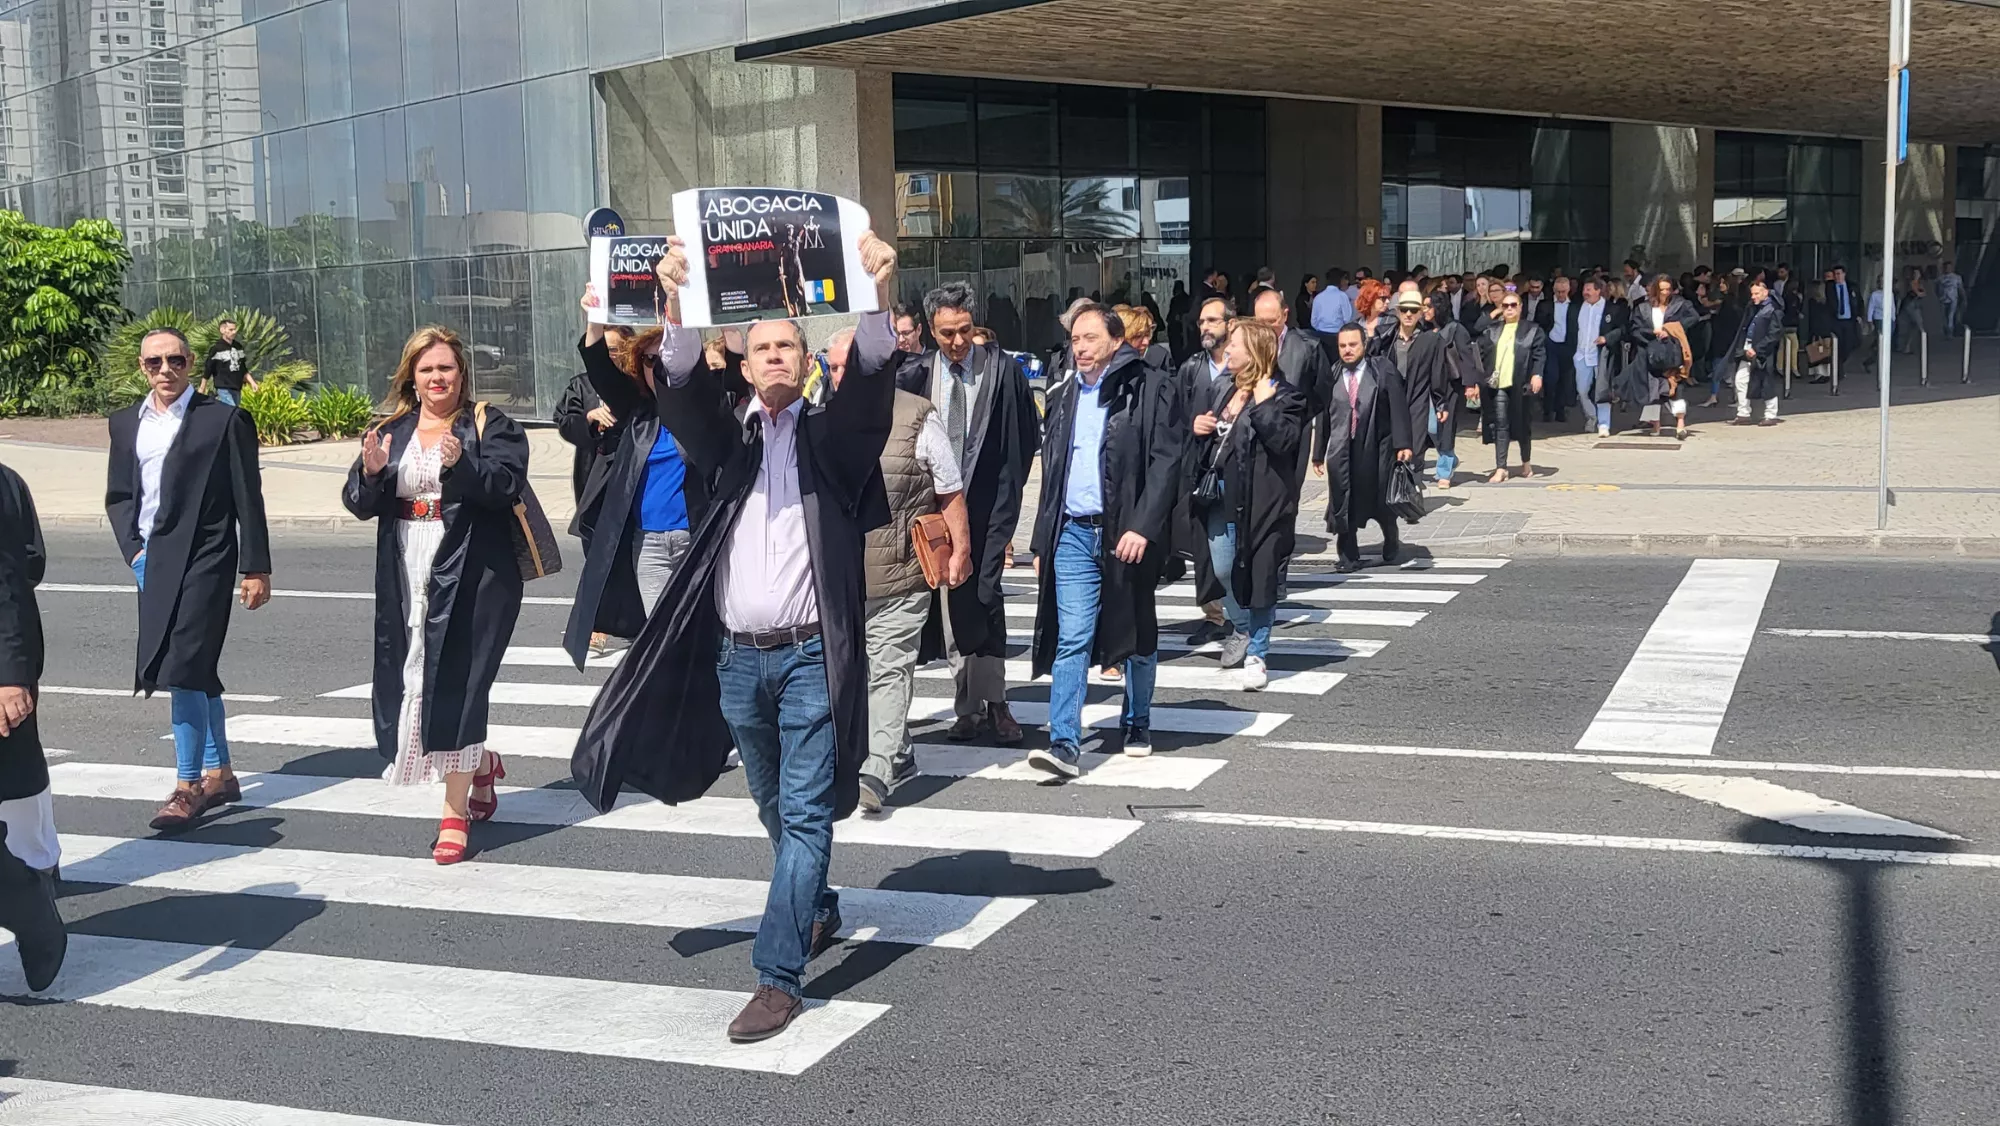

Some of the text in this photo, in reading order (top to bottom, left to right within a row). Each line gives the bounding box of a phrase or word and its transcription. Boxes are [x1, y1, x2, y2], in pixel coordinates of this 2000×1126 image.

[705, 193, 822, 218] ABOGACÍA
[706, 216, 772, 242] UNIDA
[612, 243, 670, 257] ABOGAC
[611, 259, 652, 272] UNIDA
